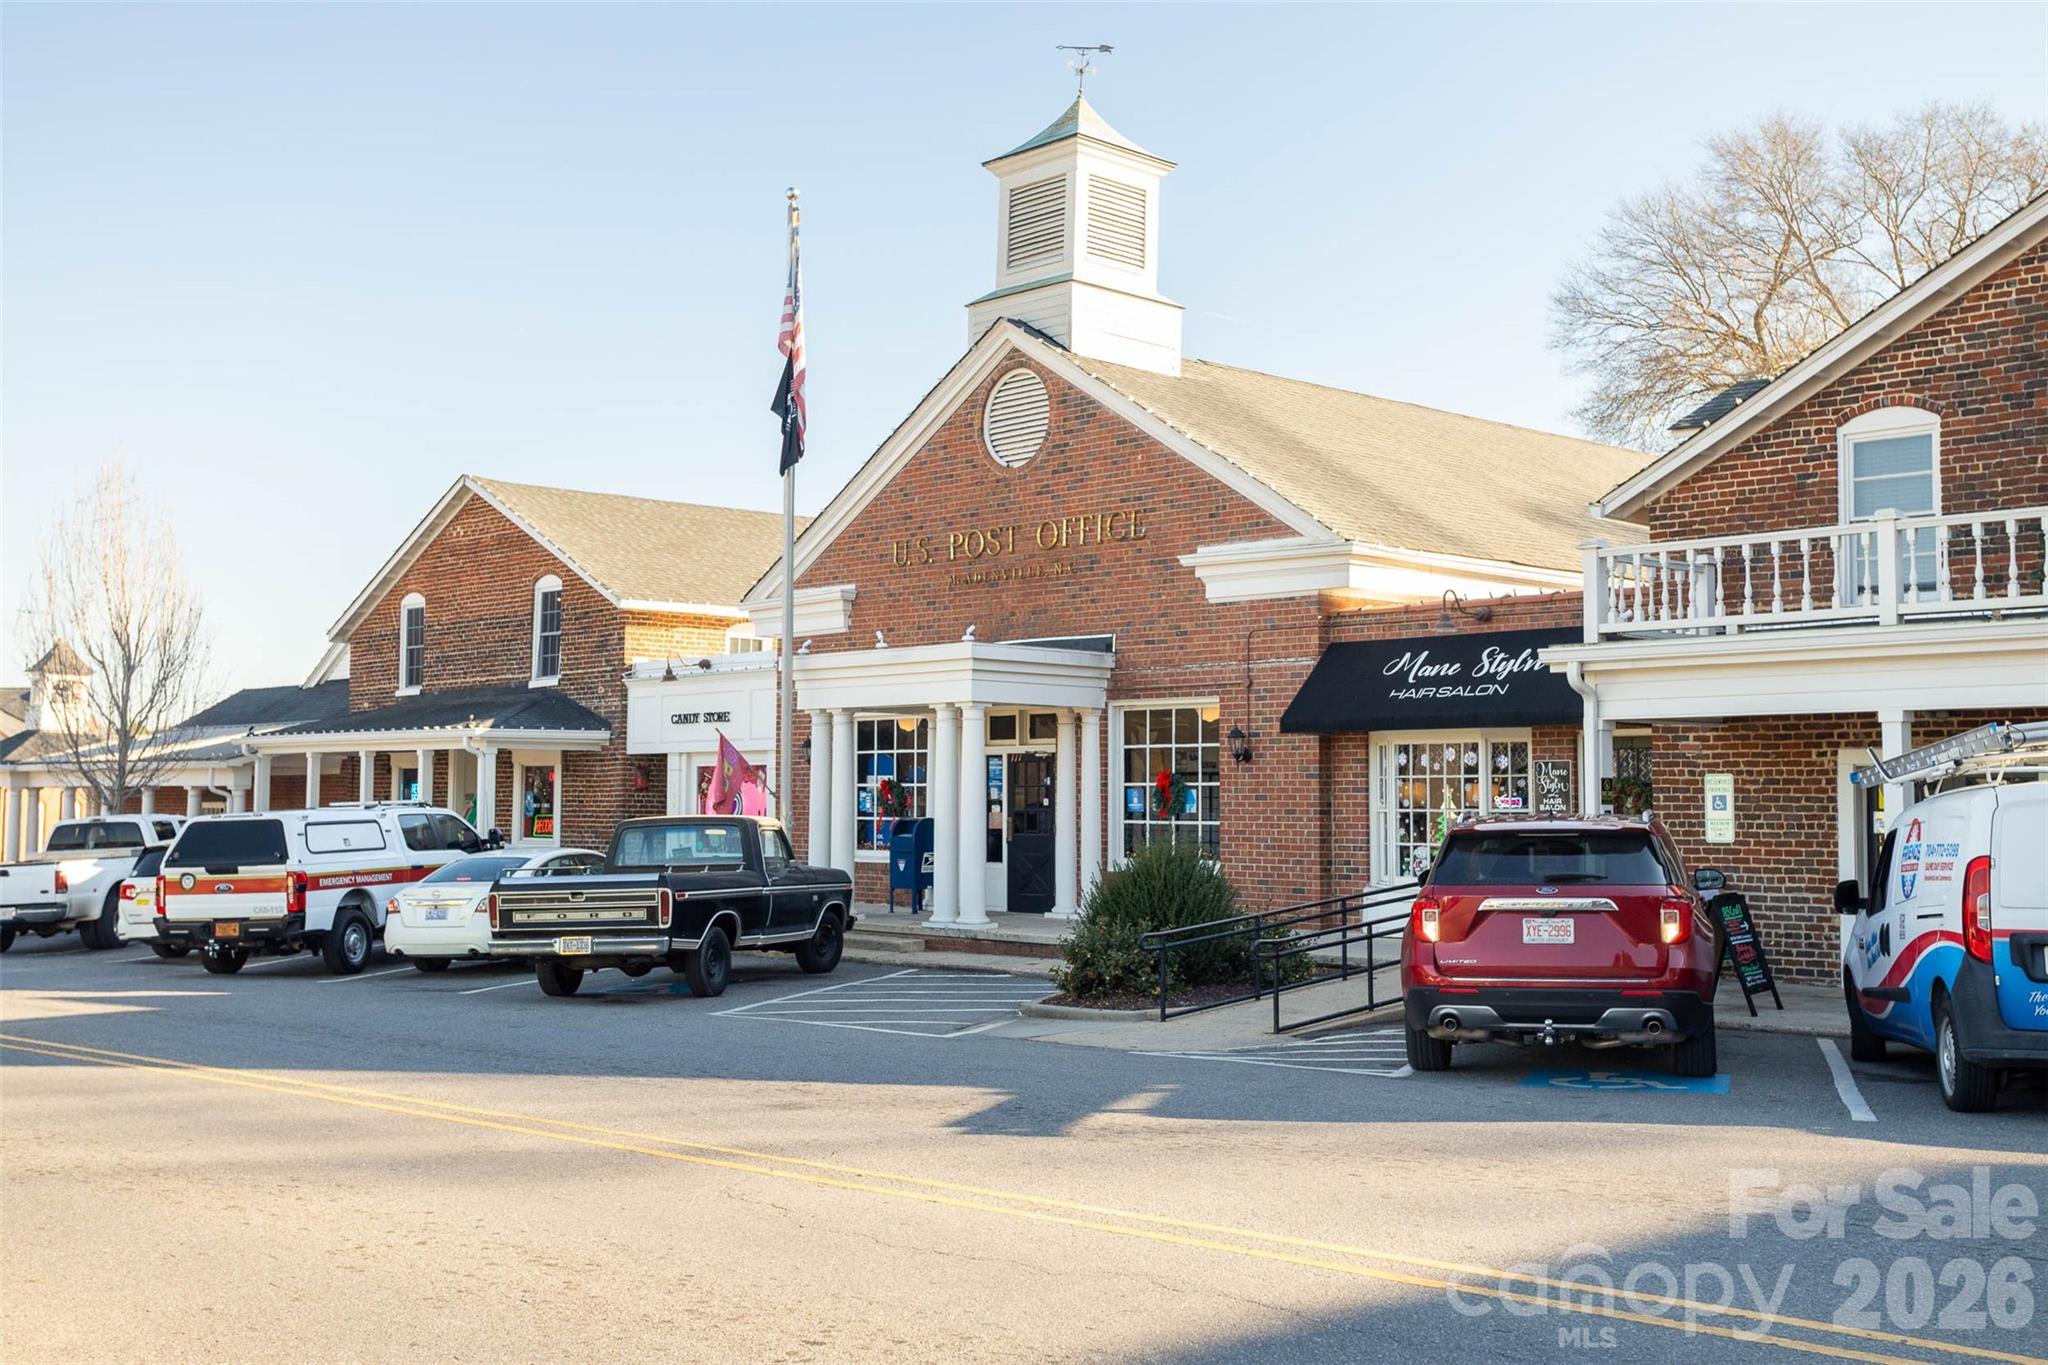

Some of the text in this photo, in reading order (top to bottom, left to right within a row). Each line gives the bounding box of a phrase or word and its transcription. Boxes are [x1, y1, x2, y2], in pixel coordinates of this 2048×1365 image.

[893, 509, 1147, 567] U.S. POST OFFICE
[1382, 650, 1461, 684] Mane
[671, 711, 731, 725] CANDY STORE
[1536, 762, 1568, 779] Mane
[319, 872, 393, 887] EMERGENCY MANAGEMENT
[1526, 924, 1572, 938] XYE-2996
